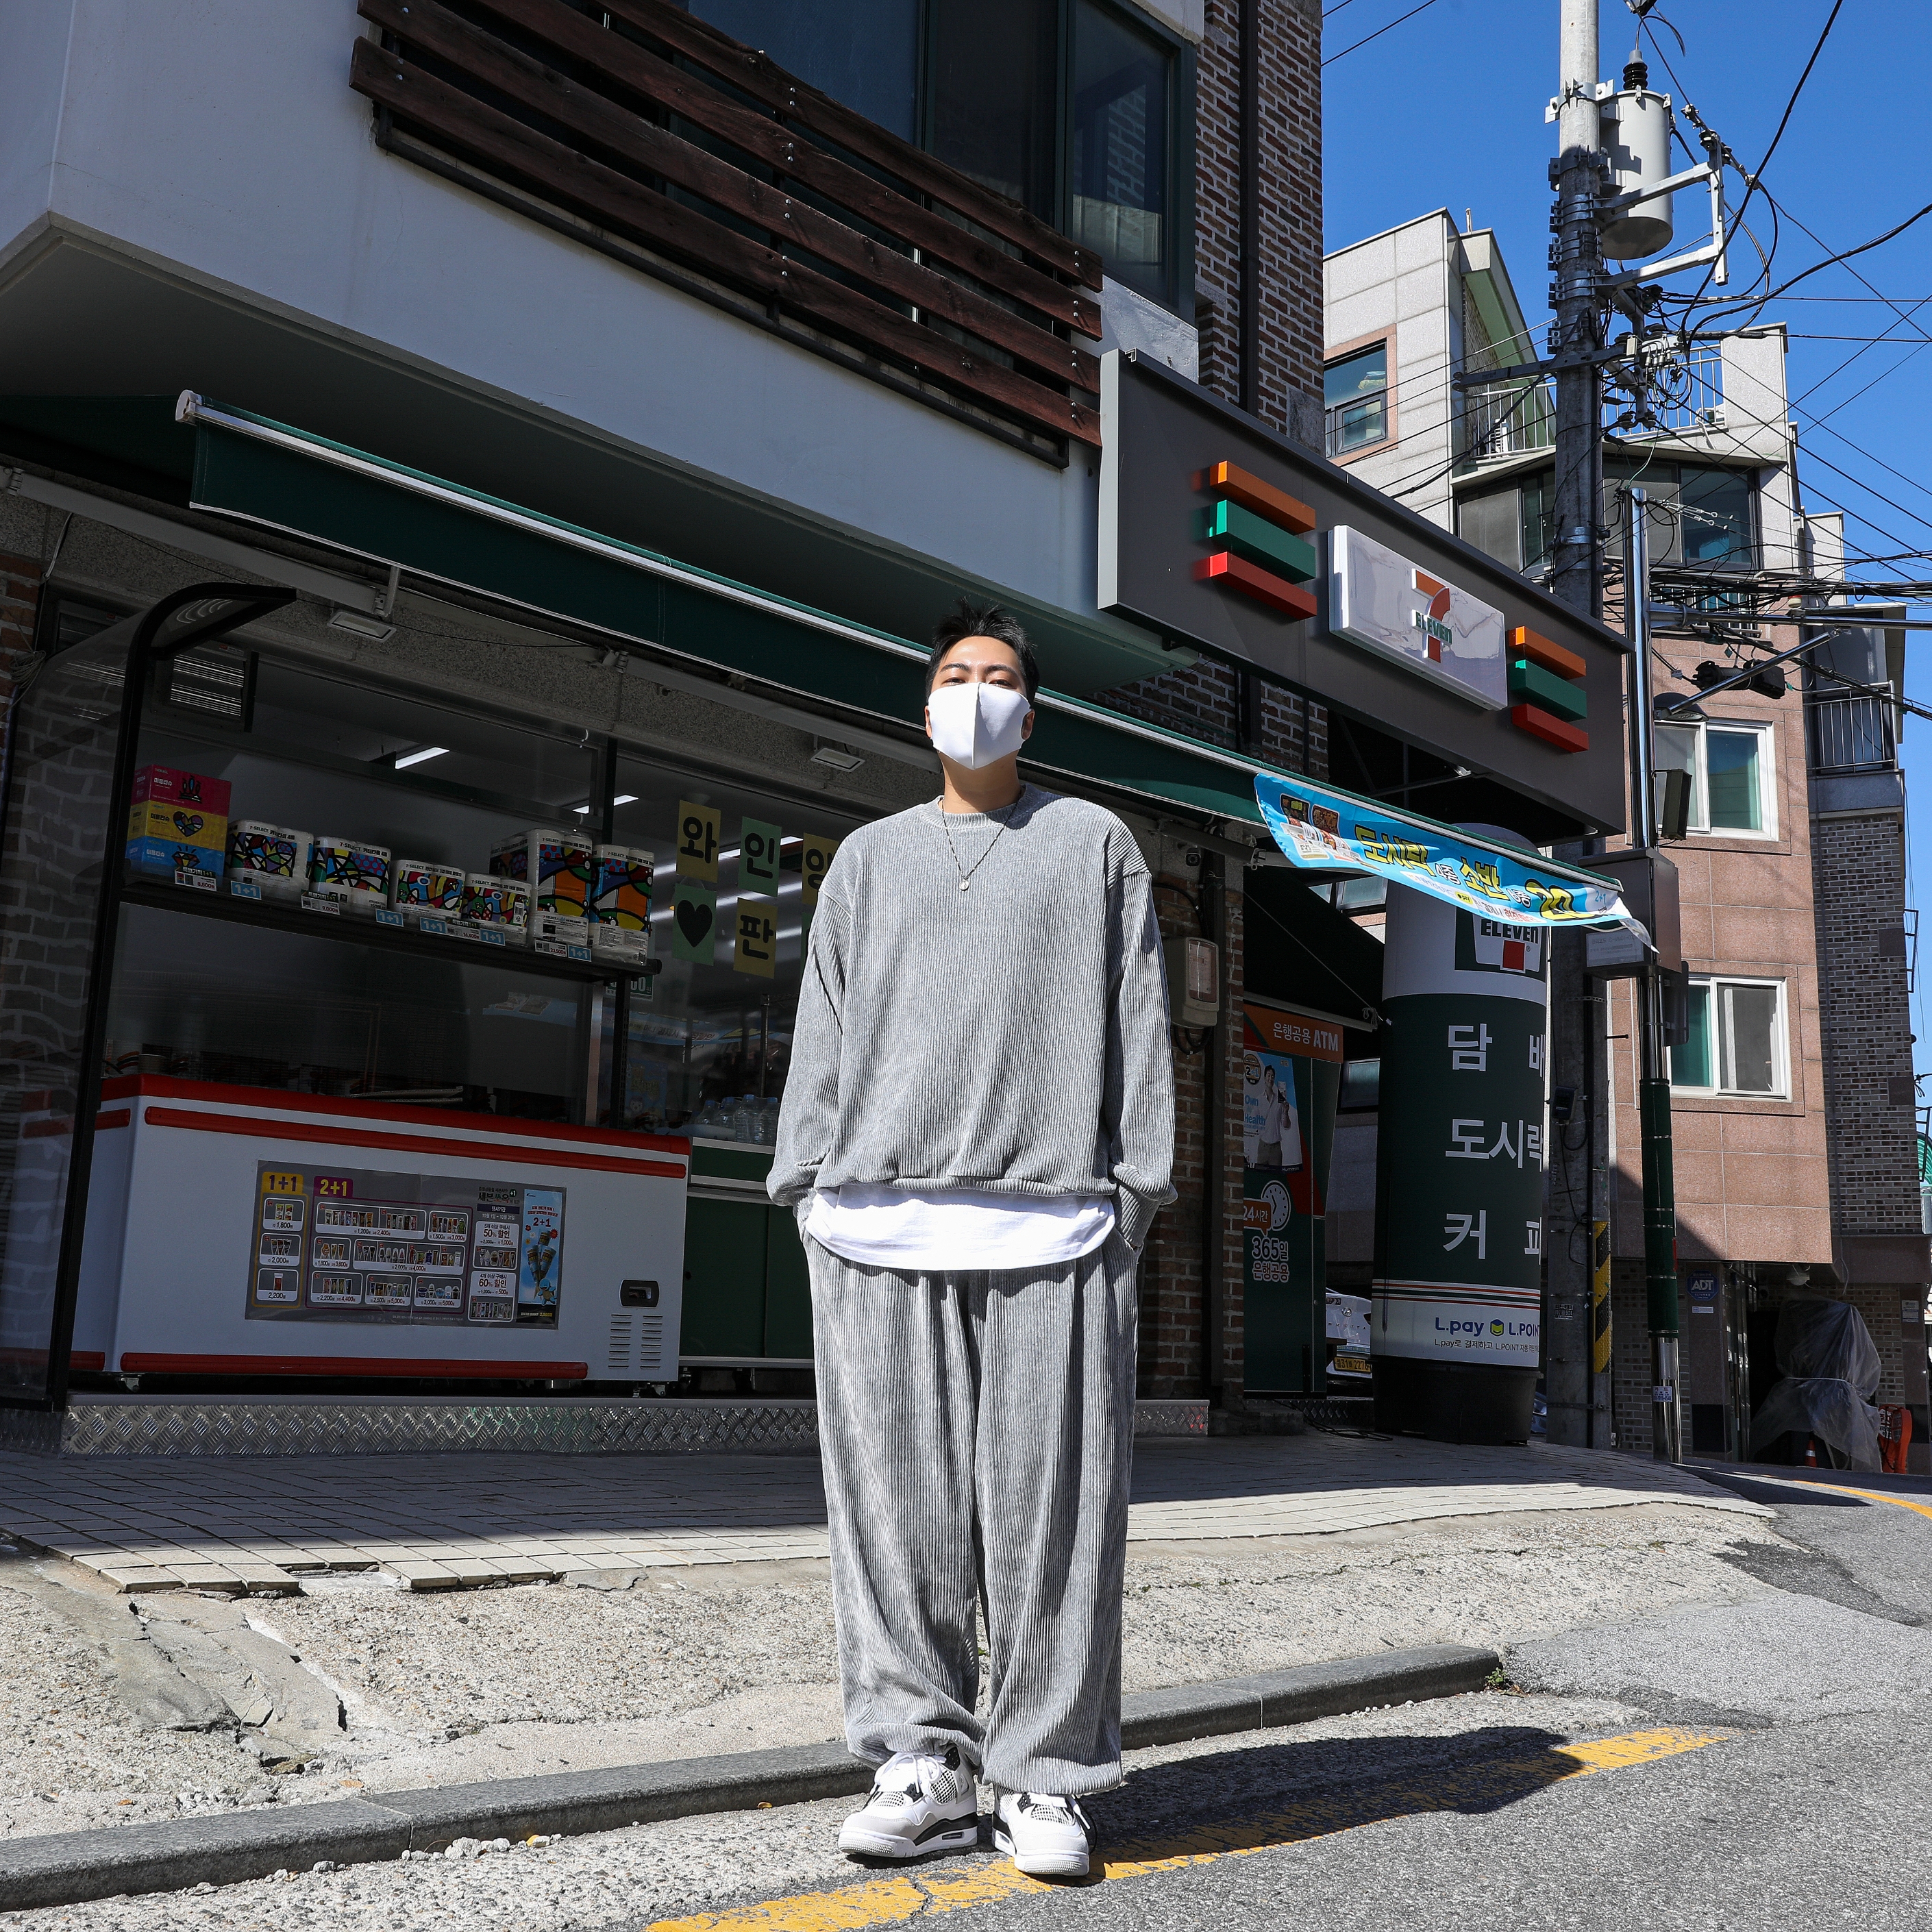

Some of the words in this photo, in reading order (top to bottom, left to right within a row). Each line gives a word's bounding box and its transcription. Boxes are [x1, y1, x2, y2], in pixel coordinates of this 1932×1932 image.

[339, 842, 361, 852] 7-SELECT
[1354, 823, 1437, 877] 도시락
[234, 884, 256, 897] 1+1
[379, 913, 399, 924] 1+1
[423, 920, 443, 932] 1+1
[483, 931, 501, 943] 1+1
[570, 948, 588, 959] 1+1
[1273, 1021, 1311, 1045] 은행공용
[1313, 1030, 1339, 1052] ATM
[1246, 1065, 1259, 1078] 2+1
[1245, 1095, 1259, 1106] Own
[1244, 1113, 1265, 1126] Health
[1446, 1118, 1543, 1172] 도시락
[269, 1174, 297, 1192] 1+1
[319, 1179, 347, 1196] 2+1
[1243, 1205, 1268, 1223] 24시간
[533, 1217, 552, 1228] 2+1
[483, 1229, 497, 1237] 50%
[1252, 1236, 1288, 1261] 365일
[1252, 1261, 1289, 1283] 은행공용
[479, 1278, 493, 1287] 60%
[1691, 1279, 1713, 1291] ADT
[1435, 1317, 1485, 1337] L.pay
[1509, 1322, 1540, 1337] L.POIN
[1434, 1339, 1461, 1348] L.pay로
[1465, 1339, 1493, 1349] 결제하고
[1495, 1343, 1519, 1352] L.POINT
